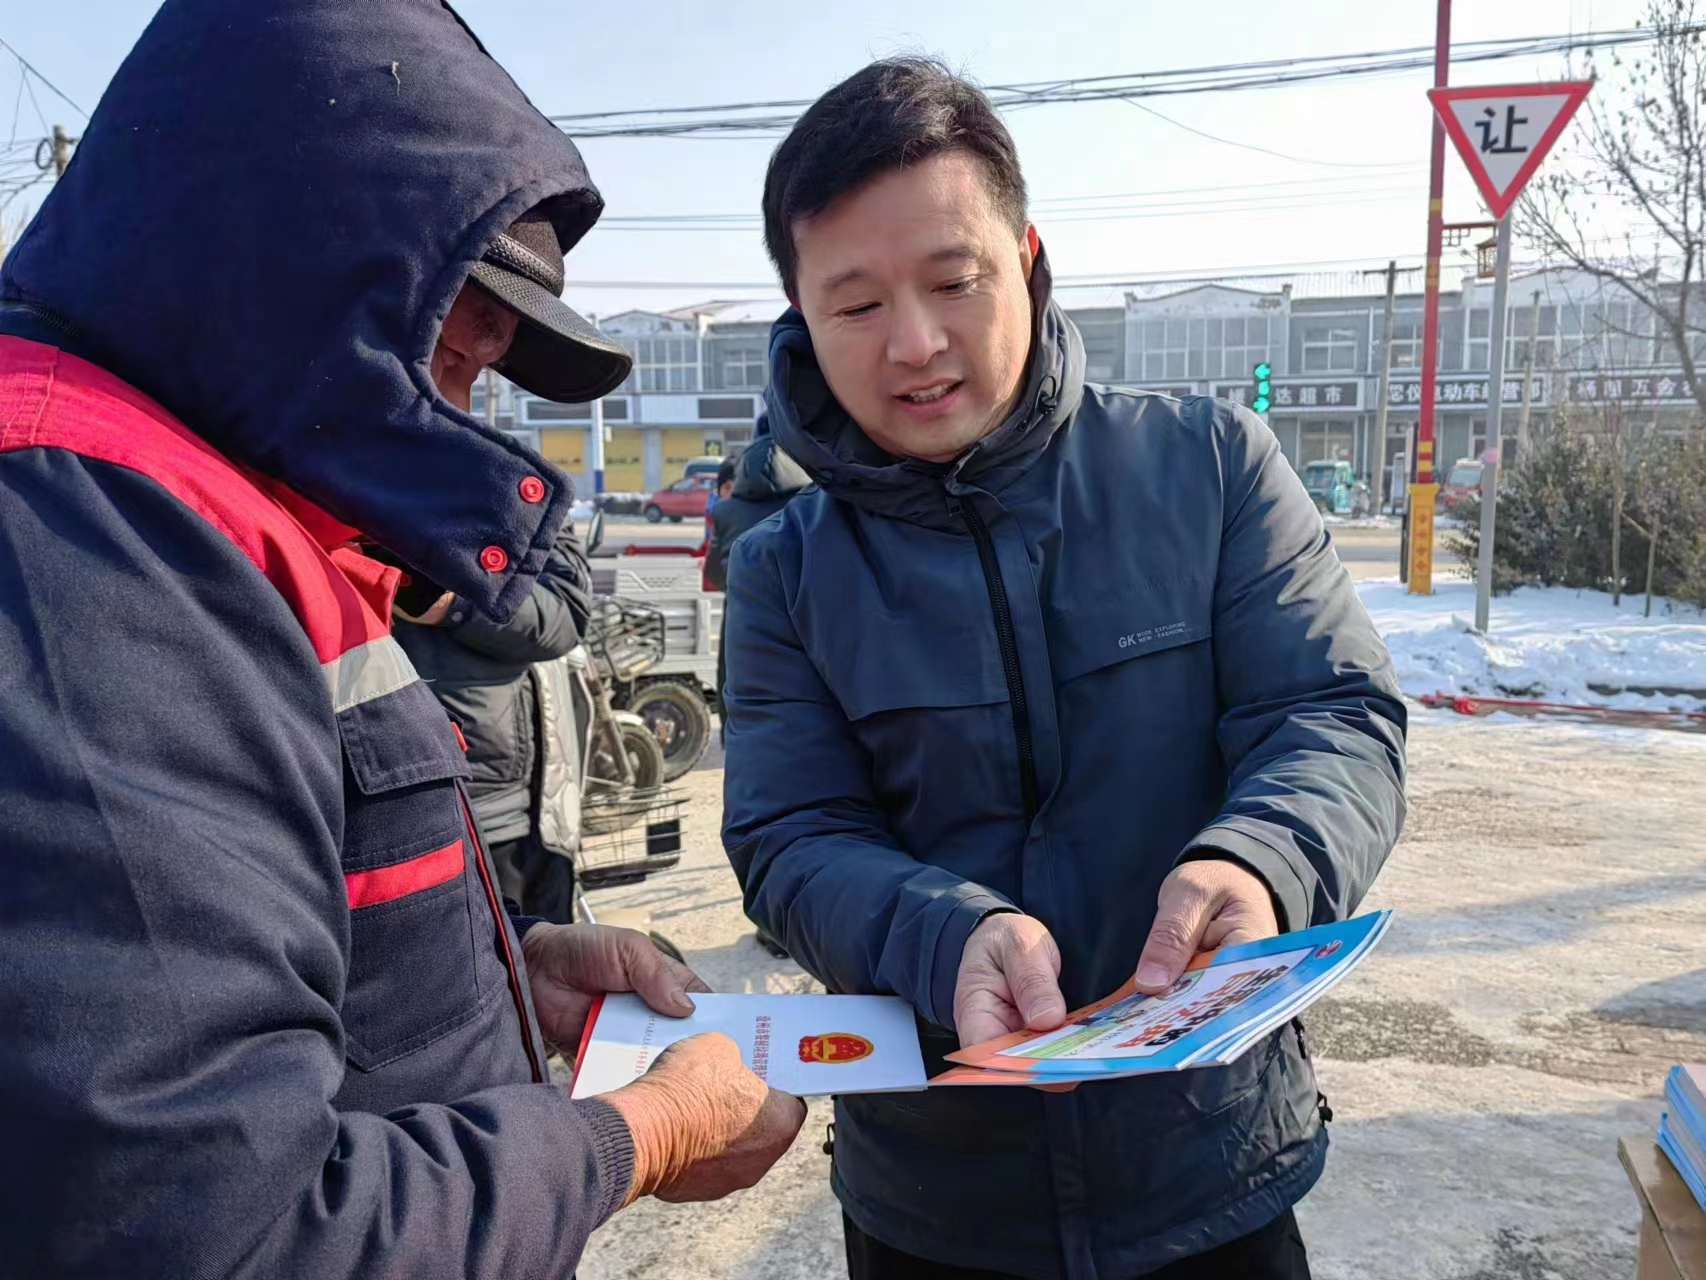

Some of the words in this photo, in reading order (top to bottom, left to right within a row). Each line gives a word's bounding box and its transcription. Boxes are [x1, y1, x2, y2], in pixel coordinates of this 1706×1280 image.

[1474, 105, 1529, 154] 让
[1154, 621, 1186, 633] EXPLORING
[1118, 633, 1137, 649] GK
[1138, 635, 1153, 643] NEW
